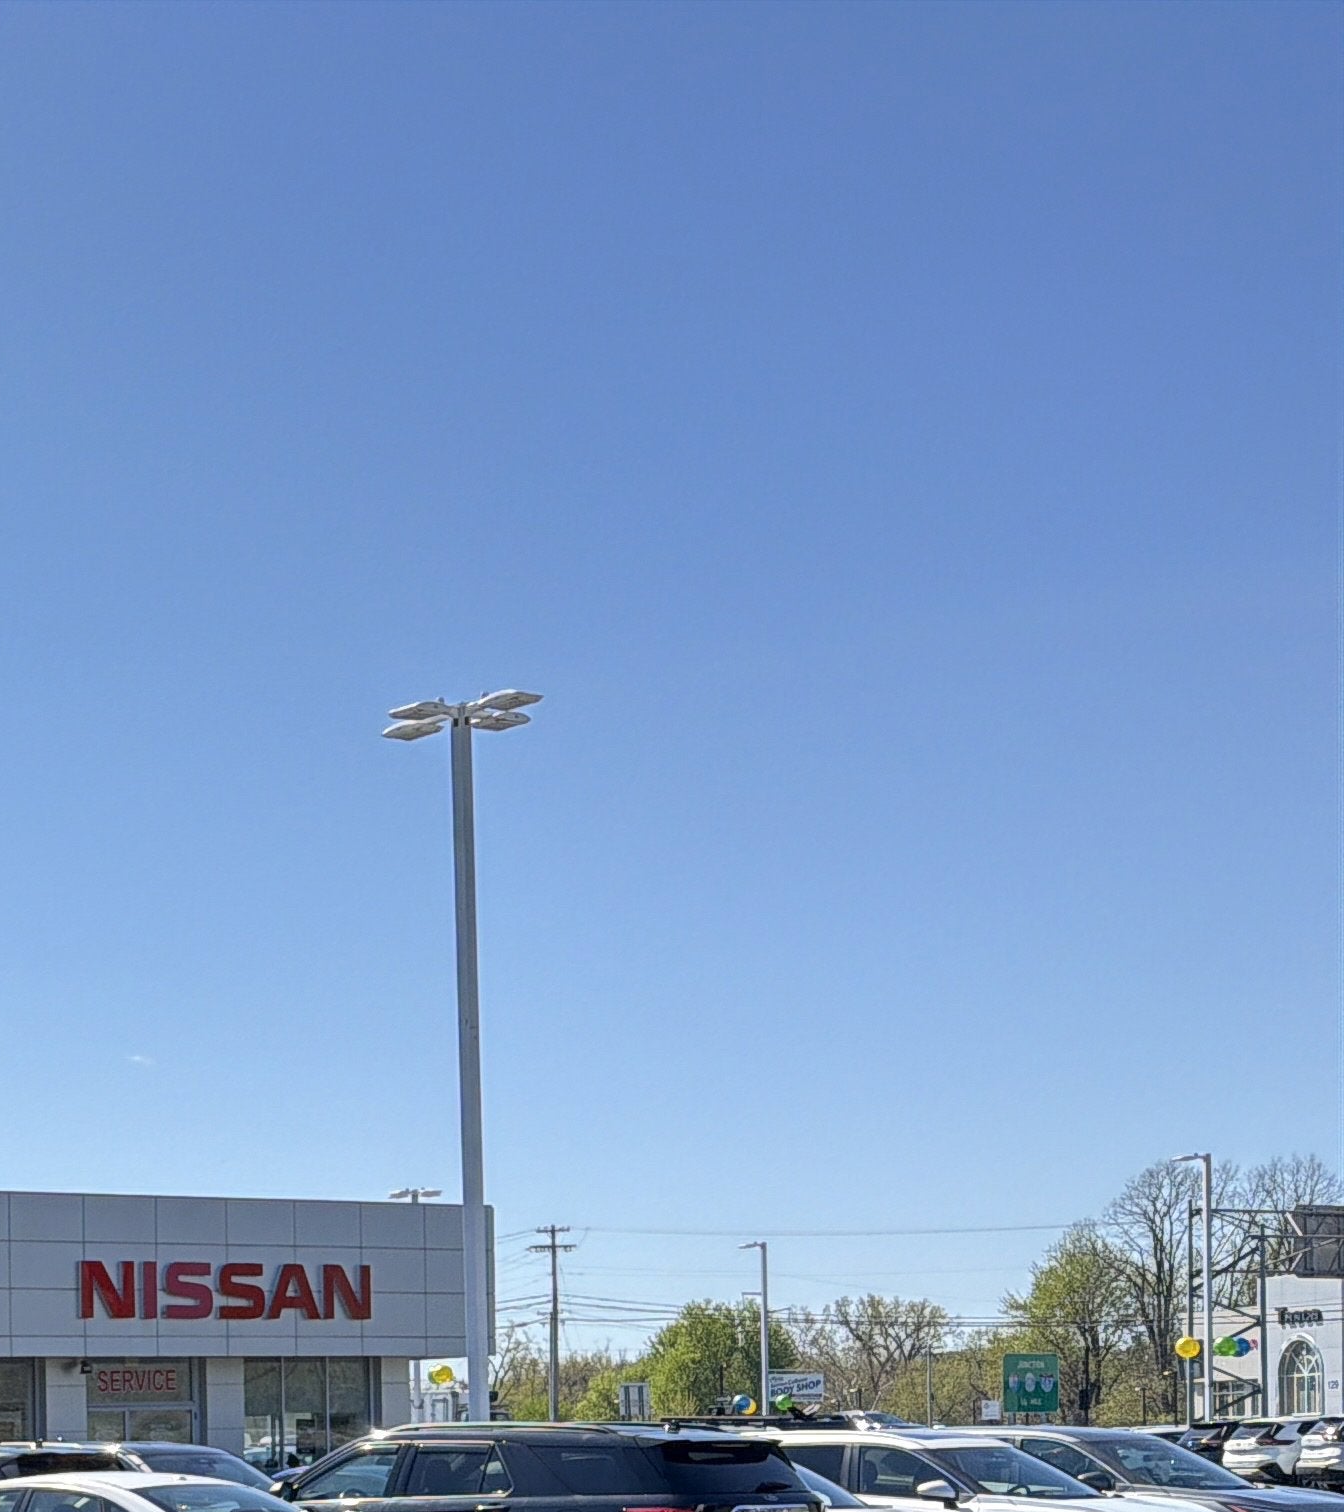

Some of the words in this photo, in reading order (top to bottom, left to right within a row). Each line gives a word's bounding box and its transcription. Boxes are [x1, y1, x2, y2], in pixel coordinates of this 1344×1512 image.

[79, 1260, 372, 1320] NISSAN
[97, 1369, 177, 1392] SERVICE
[770, 1385, 794, 1398] BODY
[796, 1379, 822, 1392] SHOP
